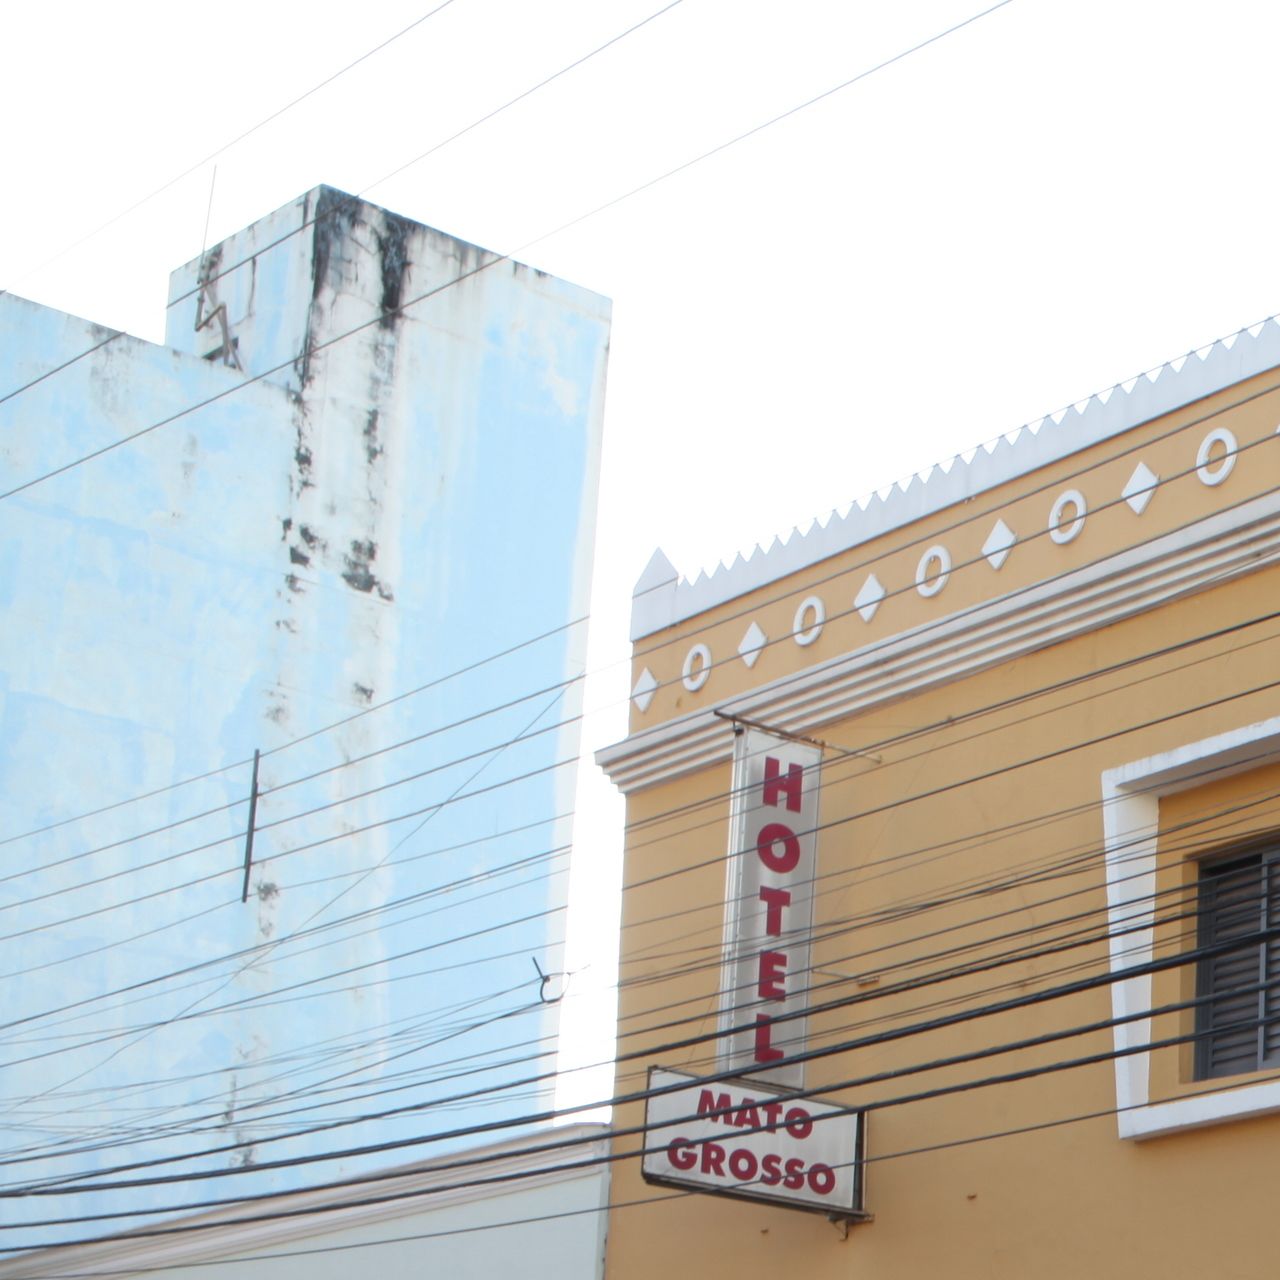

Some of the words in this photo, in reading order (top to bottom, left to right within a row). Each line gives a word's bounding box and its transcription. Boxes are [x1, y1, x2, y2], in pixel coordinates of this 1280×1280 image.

[755, 756, 803, 1062] HOTEL
[697, 1089, 813, 1140] MATO
[666, 1137, 836, 1195] GROSSO
